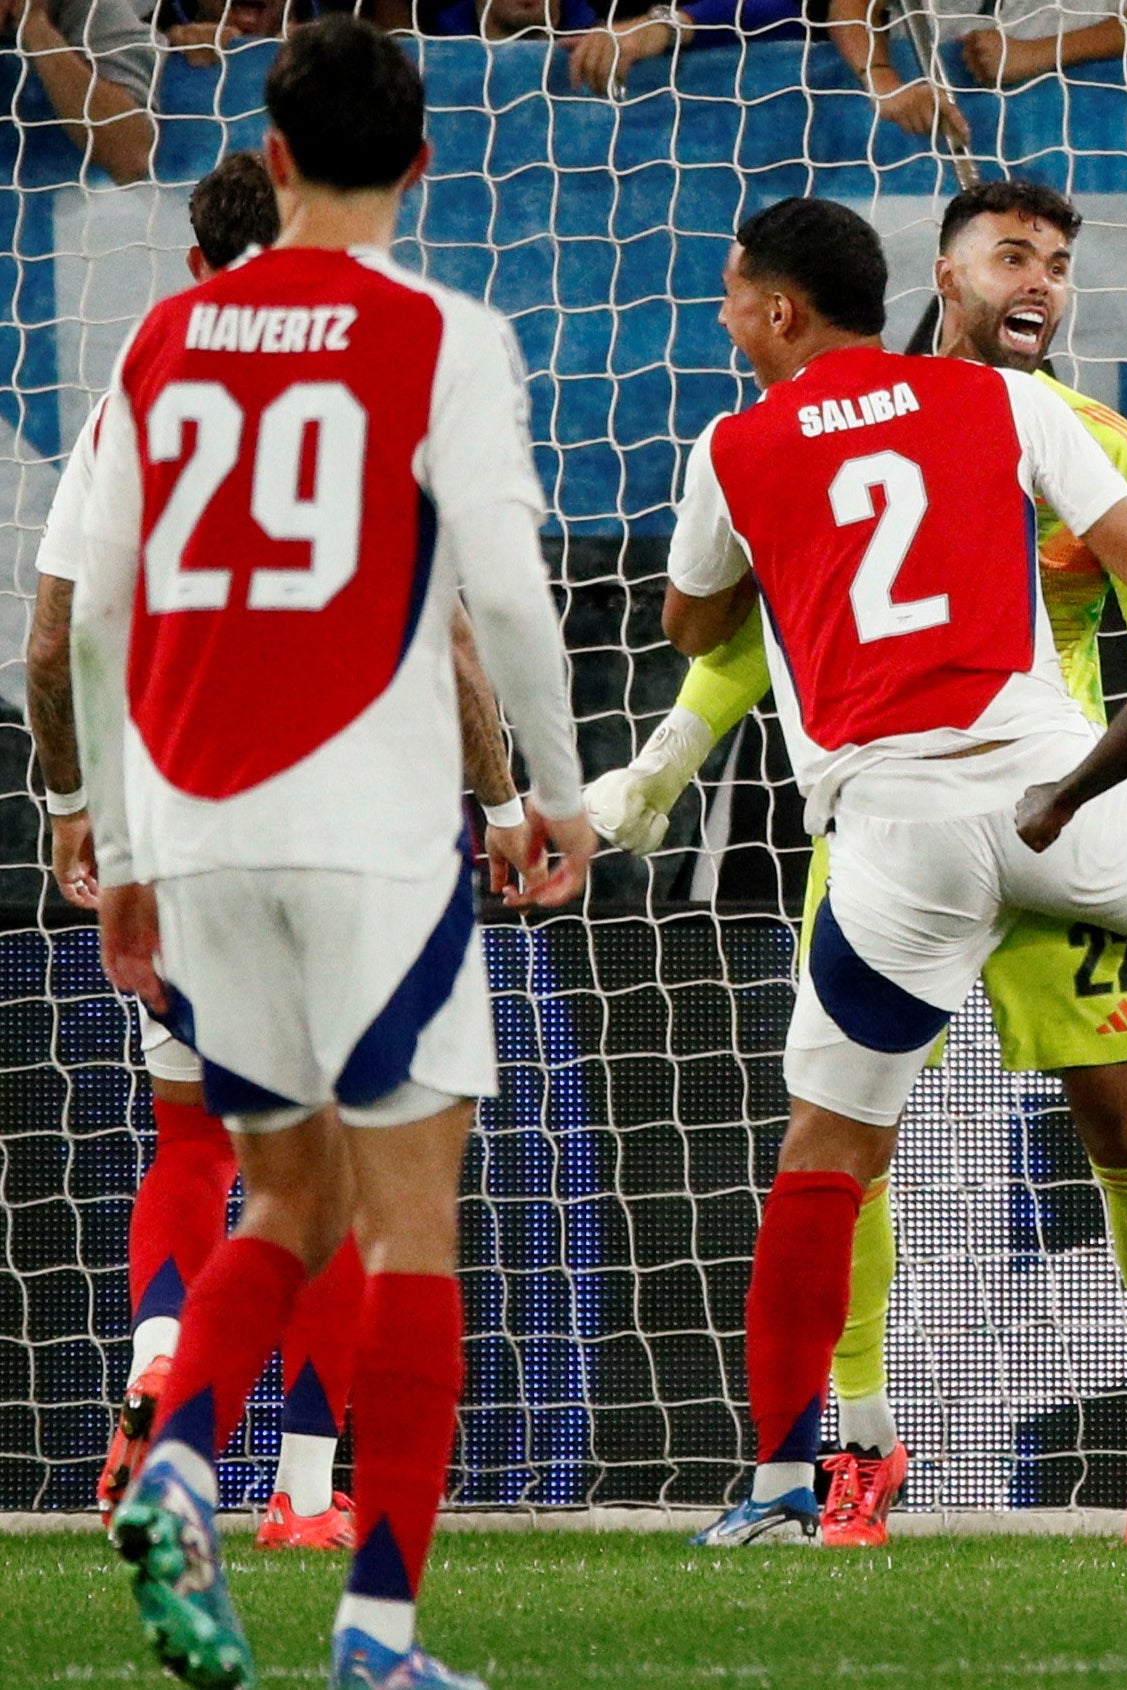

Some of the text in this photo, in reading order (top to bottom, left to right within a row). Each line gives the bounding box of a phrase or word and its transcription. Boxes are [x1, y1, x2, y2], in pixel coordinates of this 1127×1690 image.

[185, 303, 359, 353] HAVERTZ
[798, 381, 921, 439] SALIBA
[145, 379, 369, 615] 29
[827, 448, 951, 645] 2
